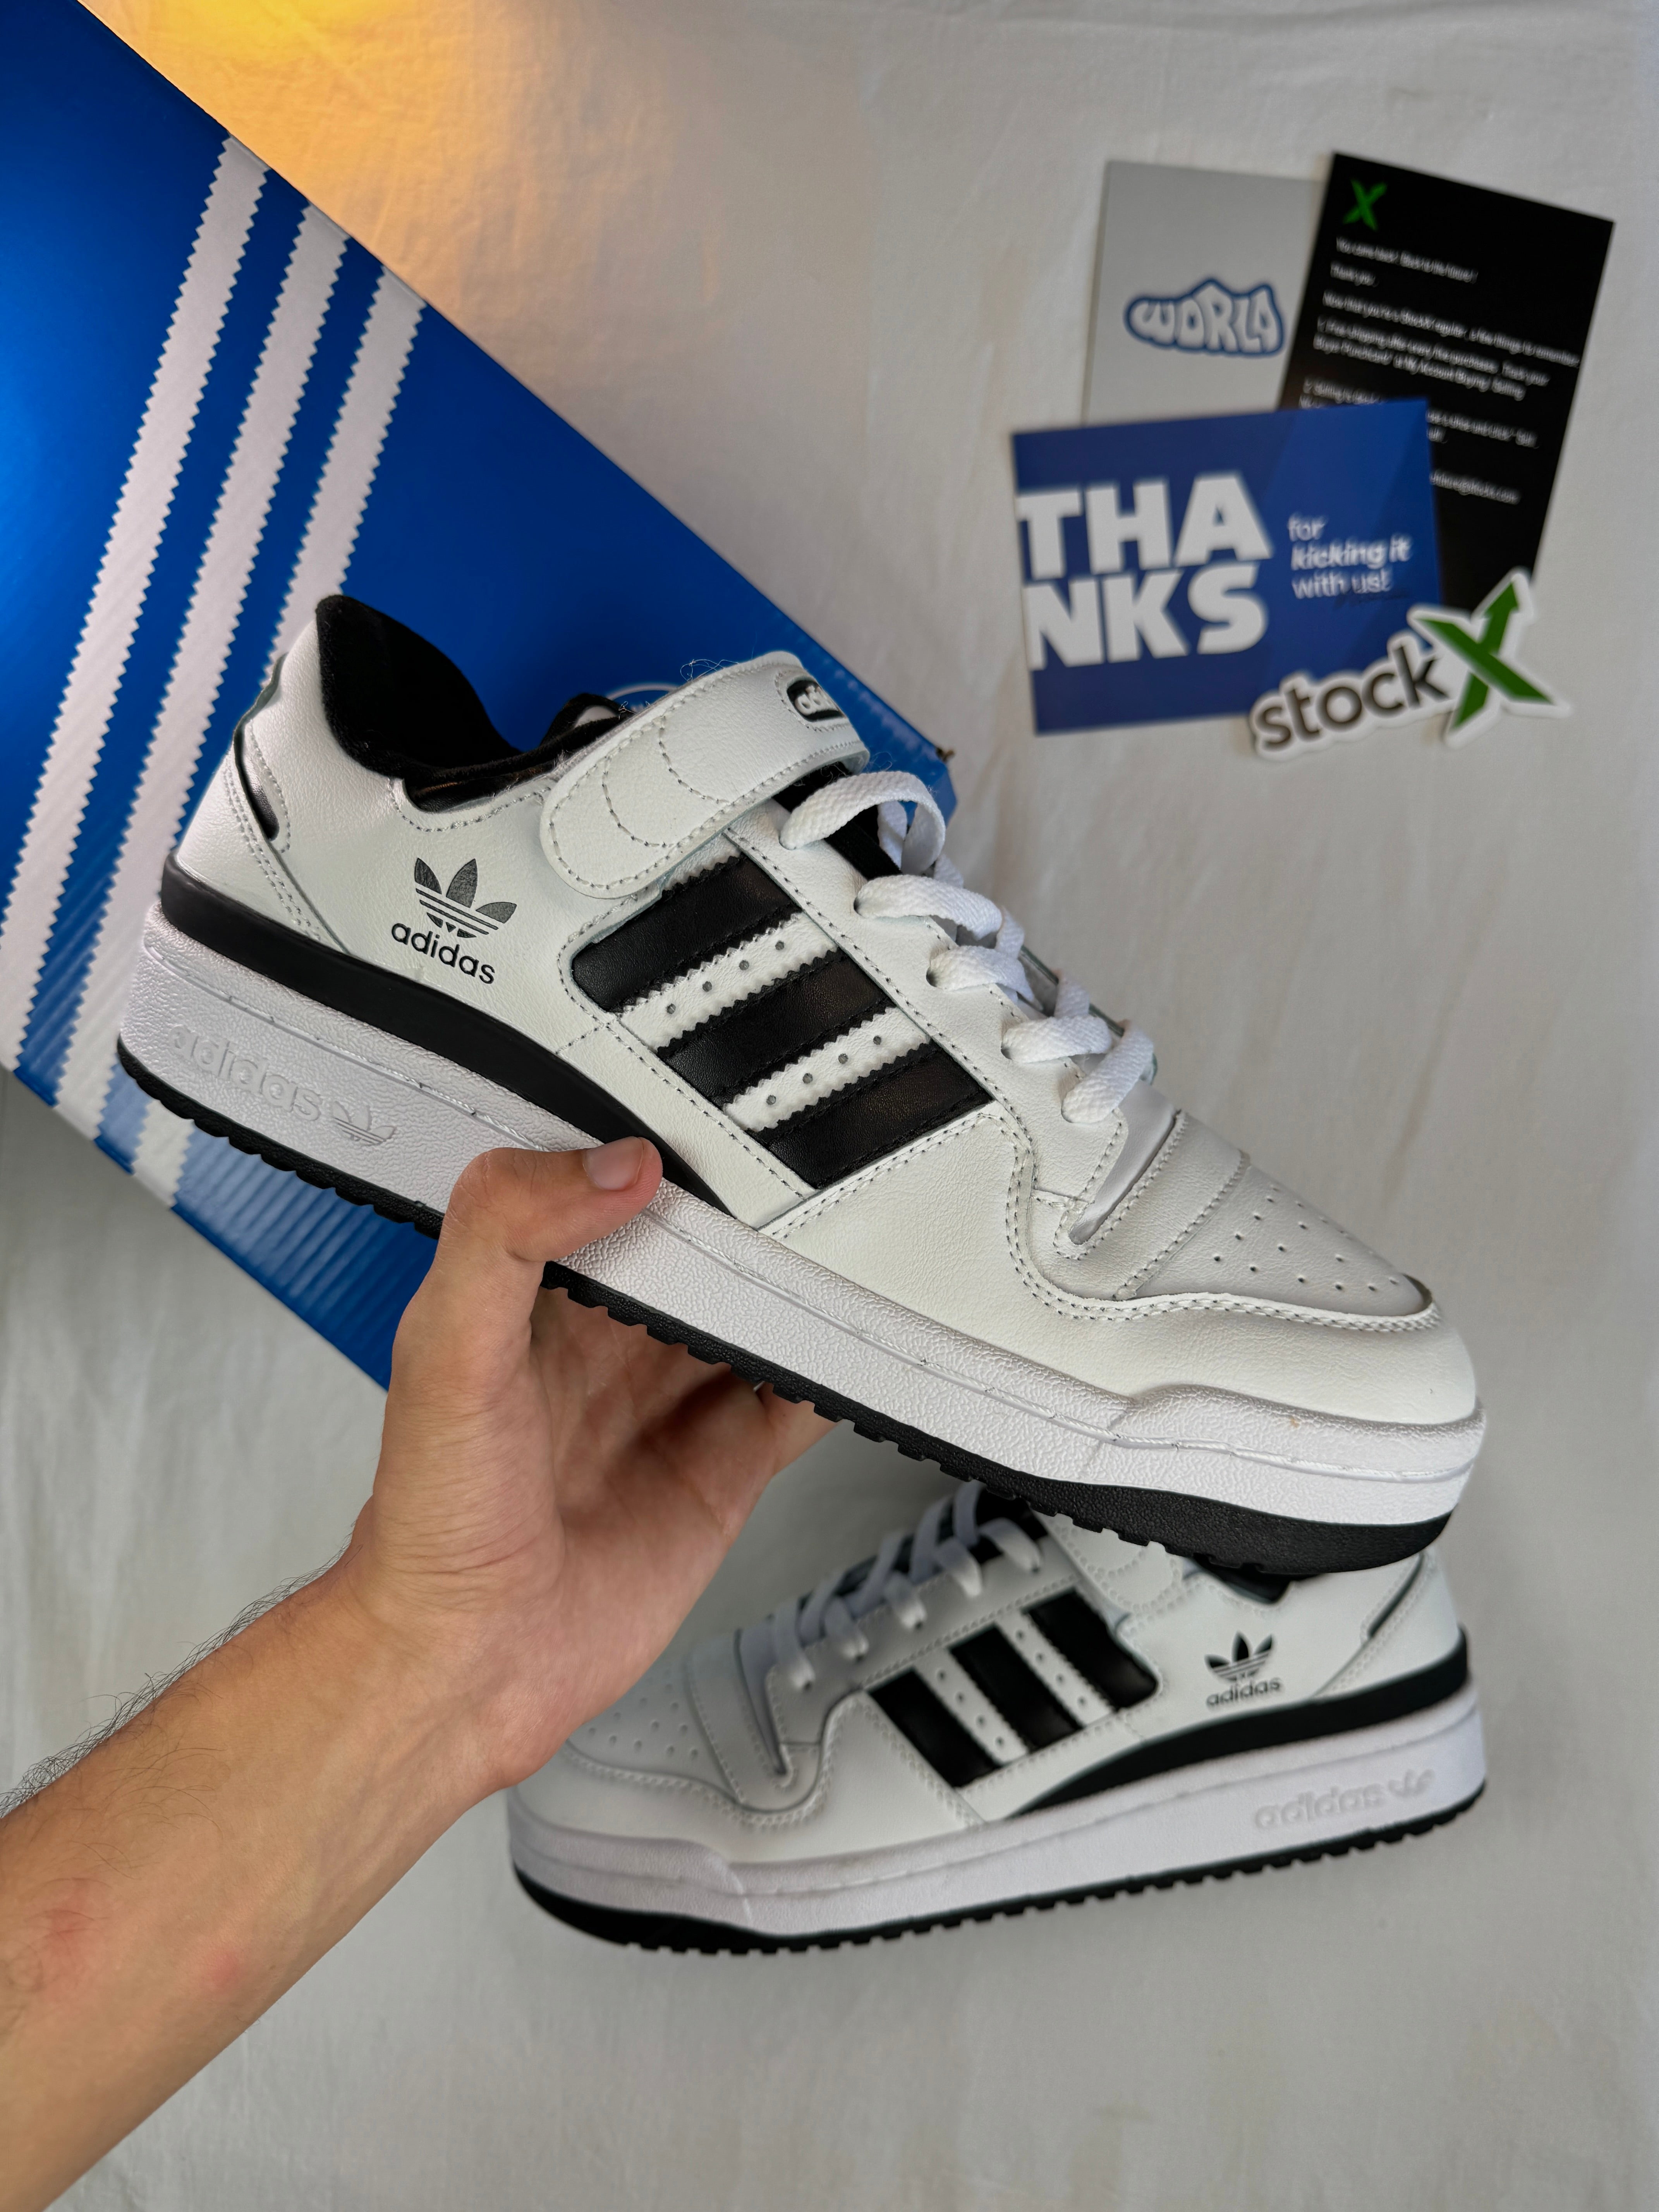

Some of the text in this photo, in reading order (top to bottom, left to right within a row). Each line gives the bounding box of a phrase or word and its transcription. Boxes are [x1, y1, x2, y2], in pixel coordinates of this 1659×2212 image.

[1016, 471, 1273, 580] THA
[1287, 512, 1326, 541] for
[1290, 532, 1412, 570] kicking it
[1291, 569, 1350, 599] with
[1022, 561, 1269, 672] NKS
[391, 923, 495, 984] adidas
[168, 1025, 323, 1121] adidas
[1206, 1677, 1282, 1708] adidas
[1254, 1785, 1385, 1829] adidas
